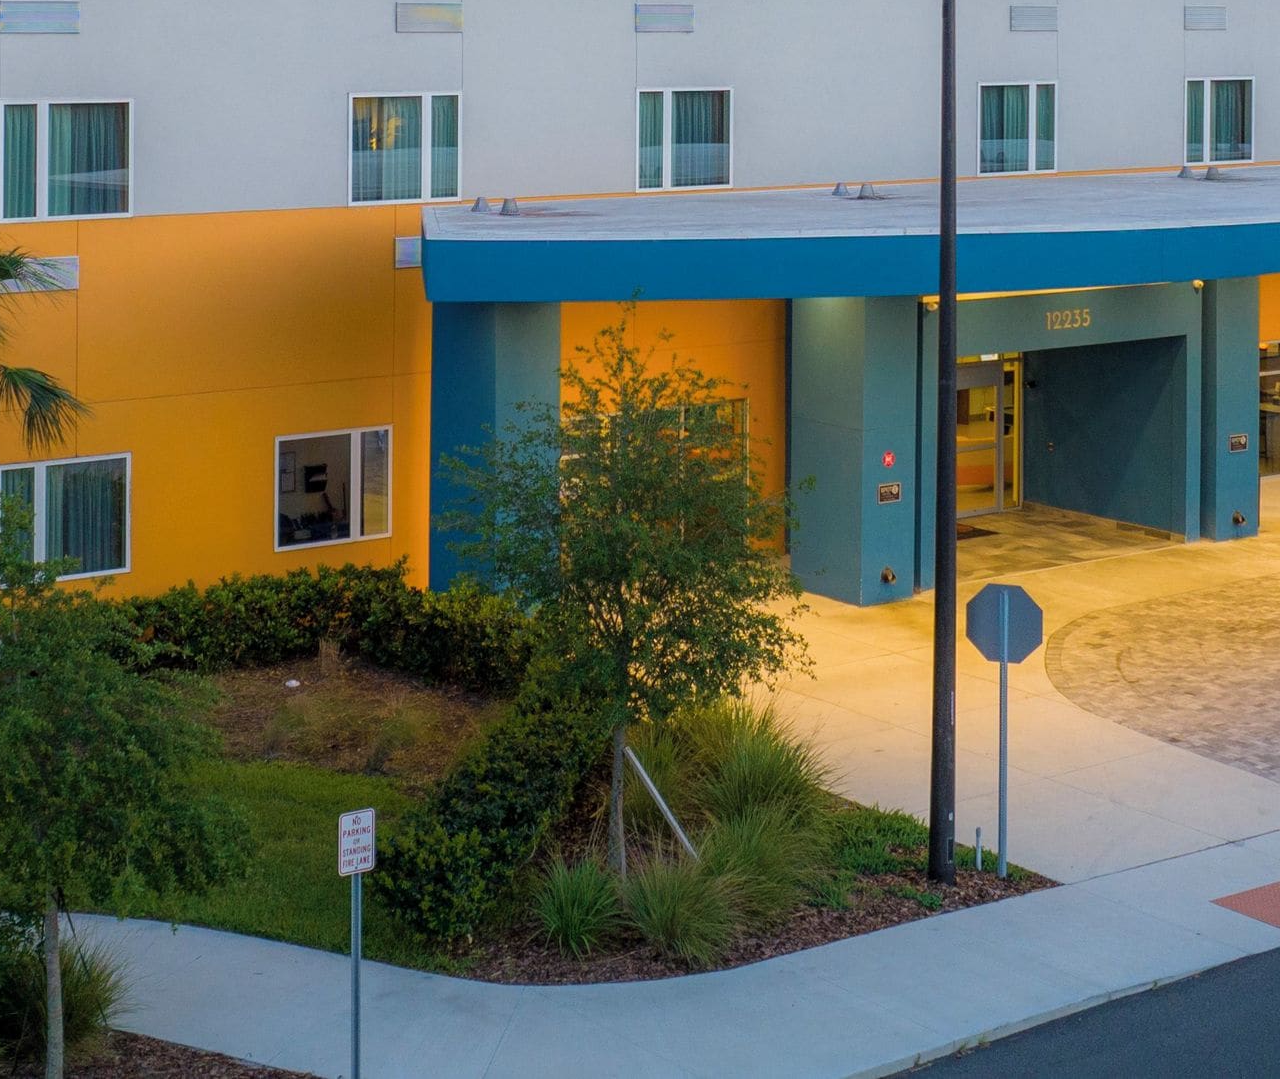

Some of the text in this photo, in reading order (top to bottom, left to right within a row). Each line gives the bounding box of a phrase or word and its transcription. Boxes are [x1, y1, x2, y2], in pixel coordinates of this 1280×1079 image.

[1046, 309, 1091, 330] 12235
[352, 817, 361, 826] NO
[343, 826, 371, 838] PARKING
[343, 845, 371, 857] STANDING
[343, 857, 370, 869] FIRE LANE
